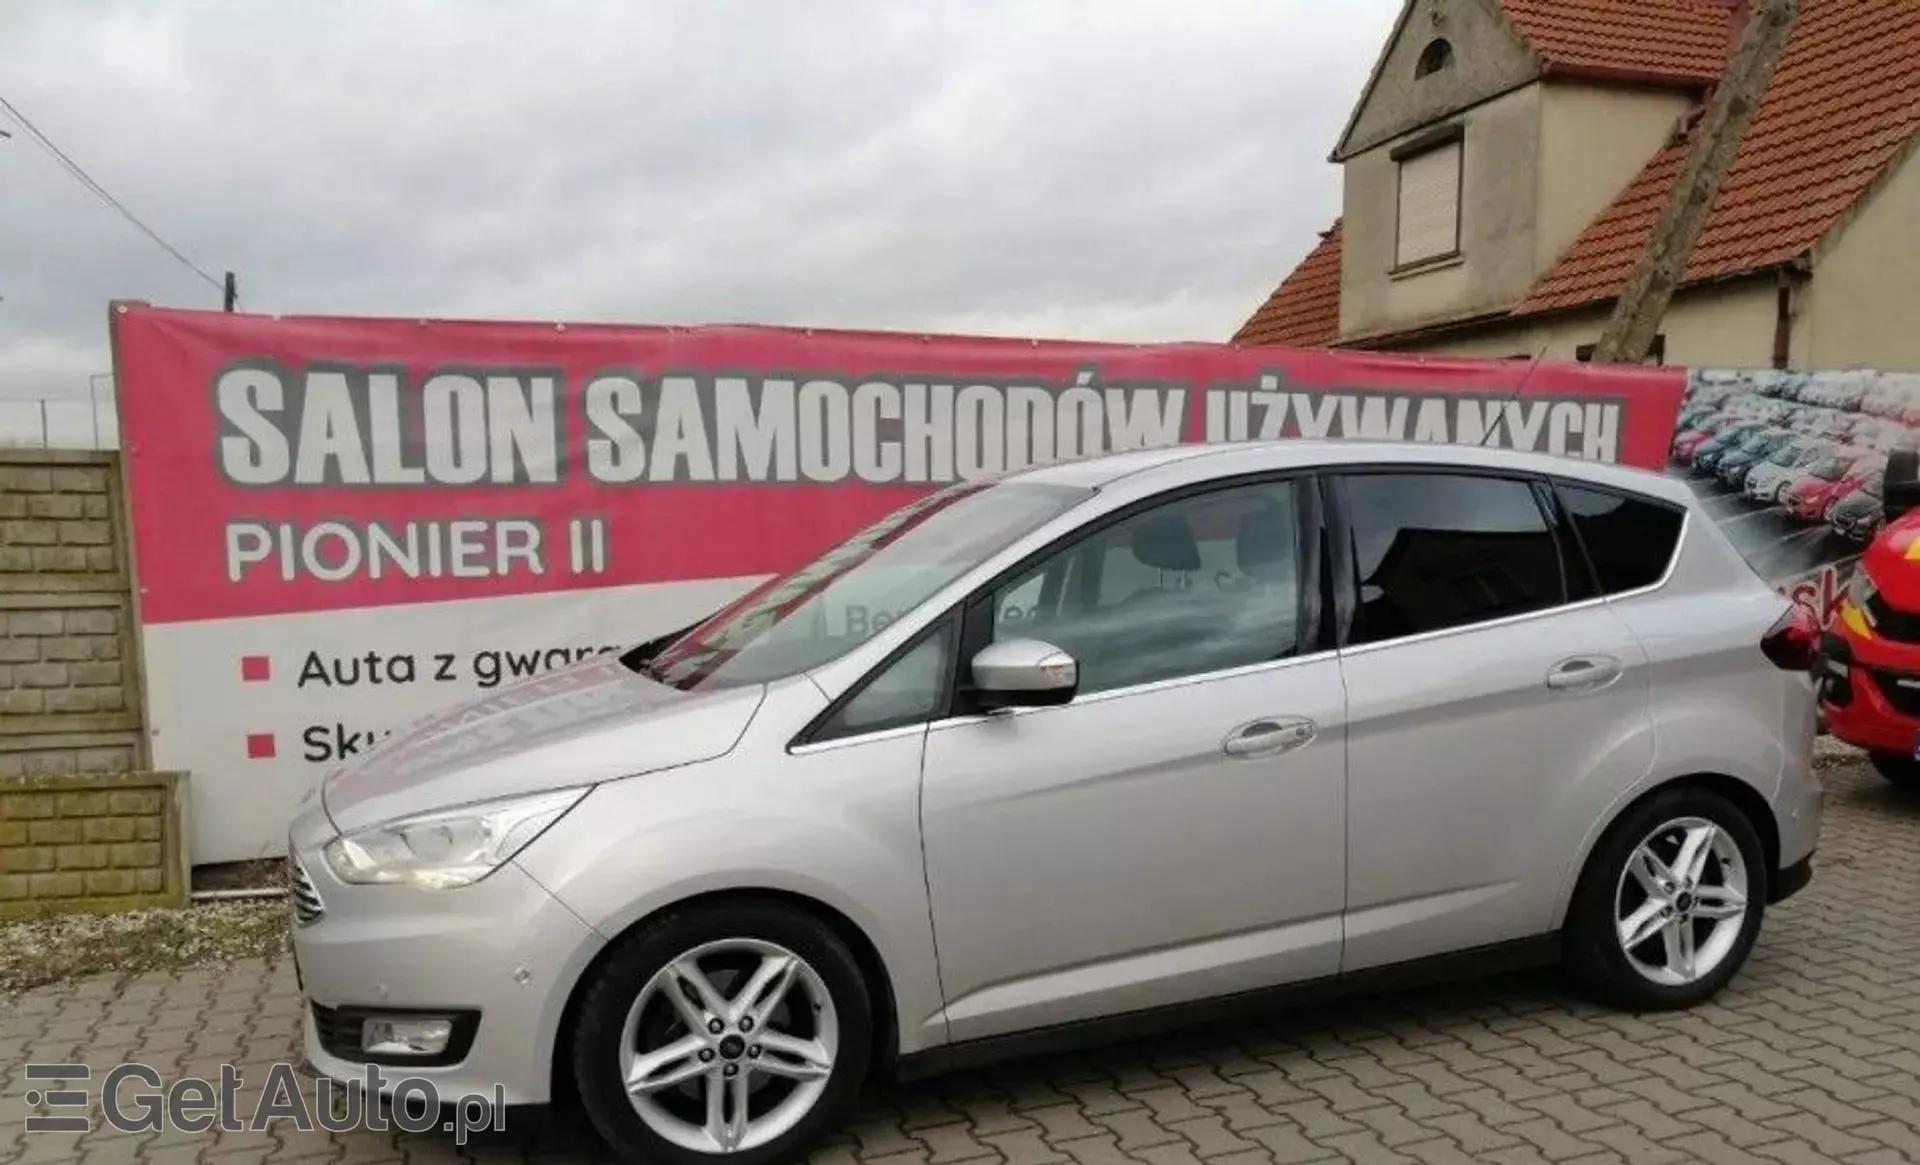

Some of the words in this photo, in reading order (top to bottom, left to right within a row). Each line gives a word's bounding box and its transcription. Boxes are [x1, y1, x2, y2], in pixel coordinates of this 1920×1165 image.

[217, 368, 559, 485] SALON
[585, 370, 1187, 483] SAMOCHODÓW
[1206, 374, 1620, 464] UŻYWANYCH
[225, 520, 543, 583] PIONIER
[569, 518, 603, 574] II
[297, 650, 416, 688] Auta
[433, 653, 457, 682] z
[472, 645, 622, 688] gwar
